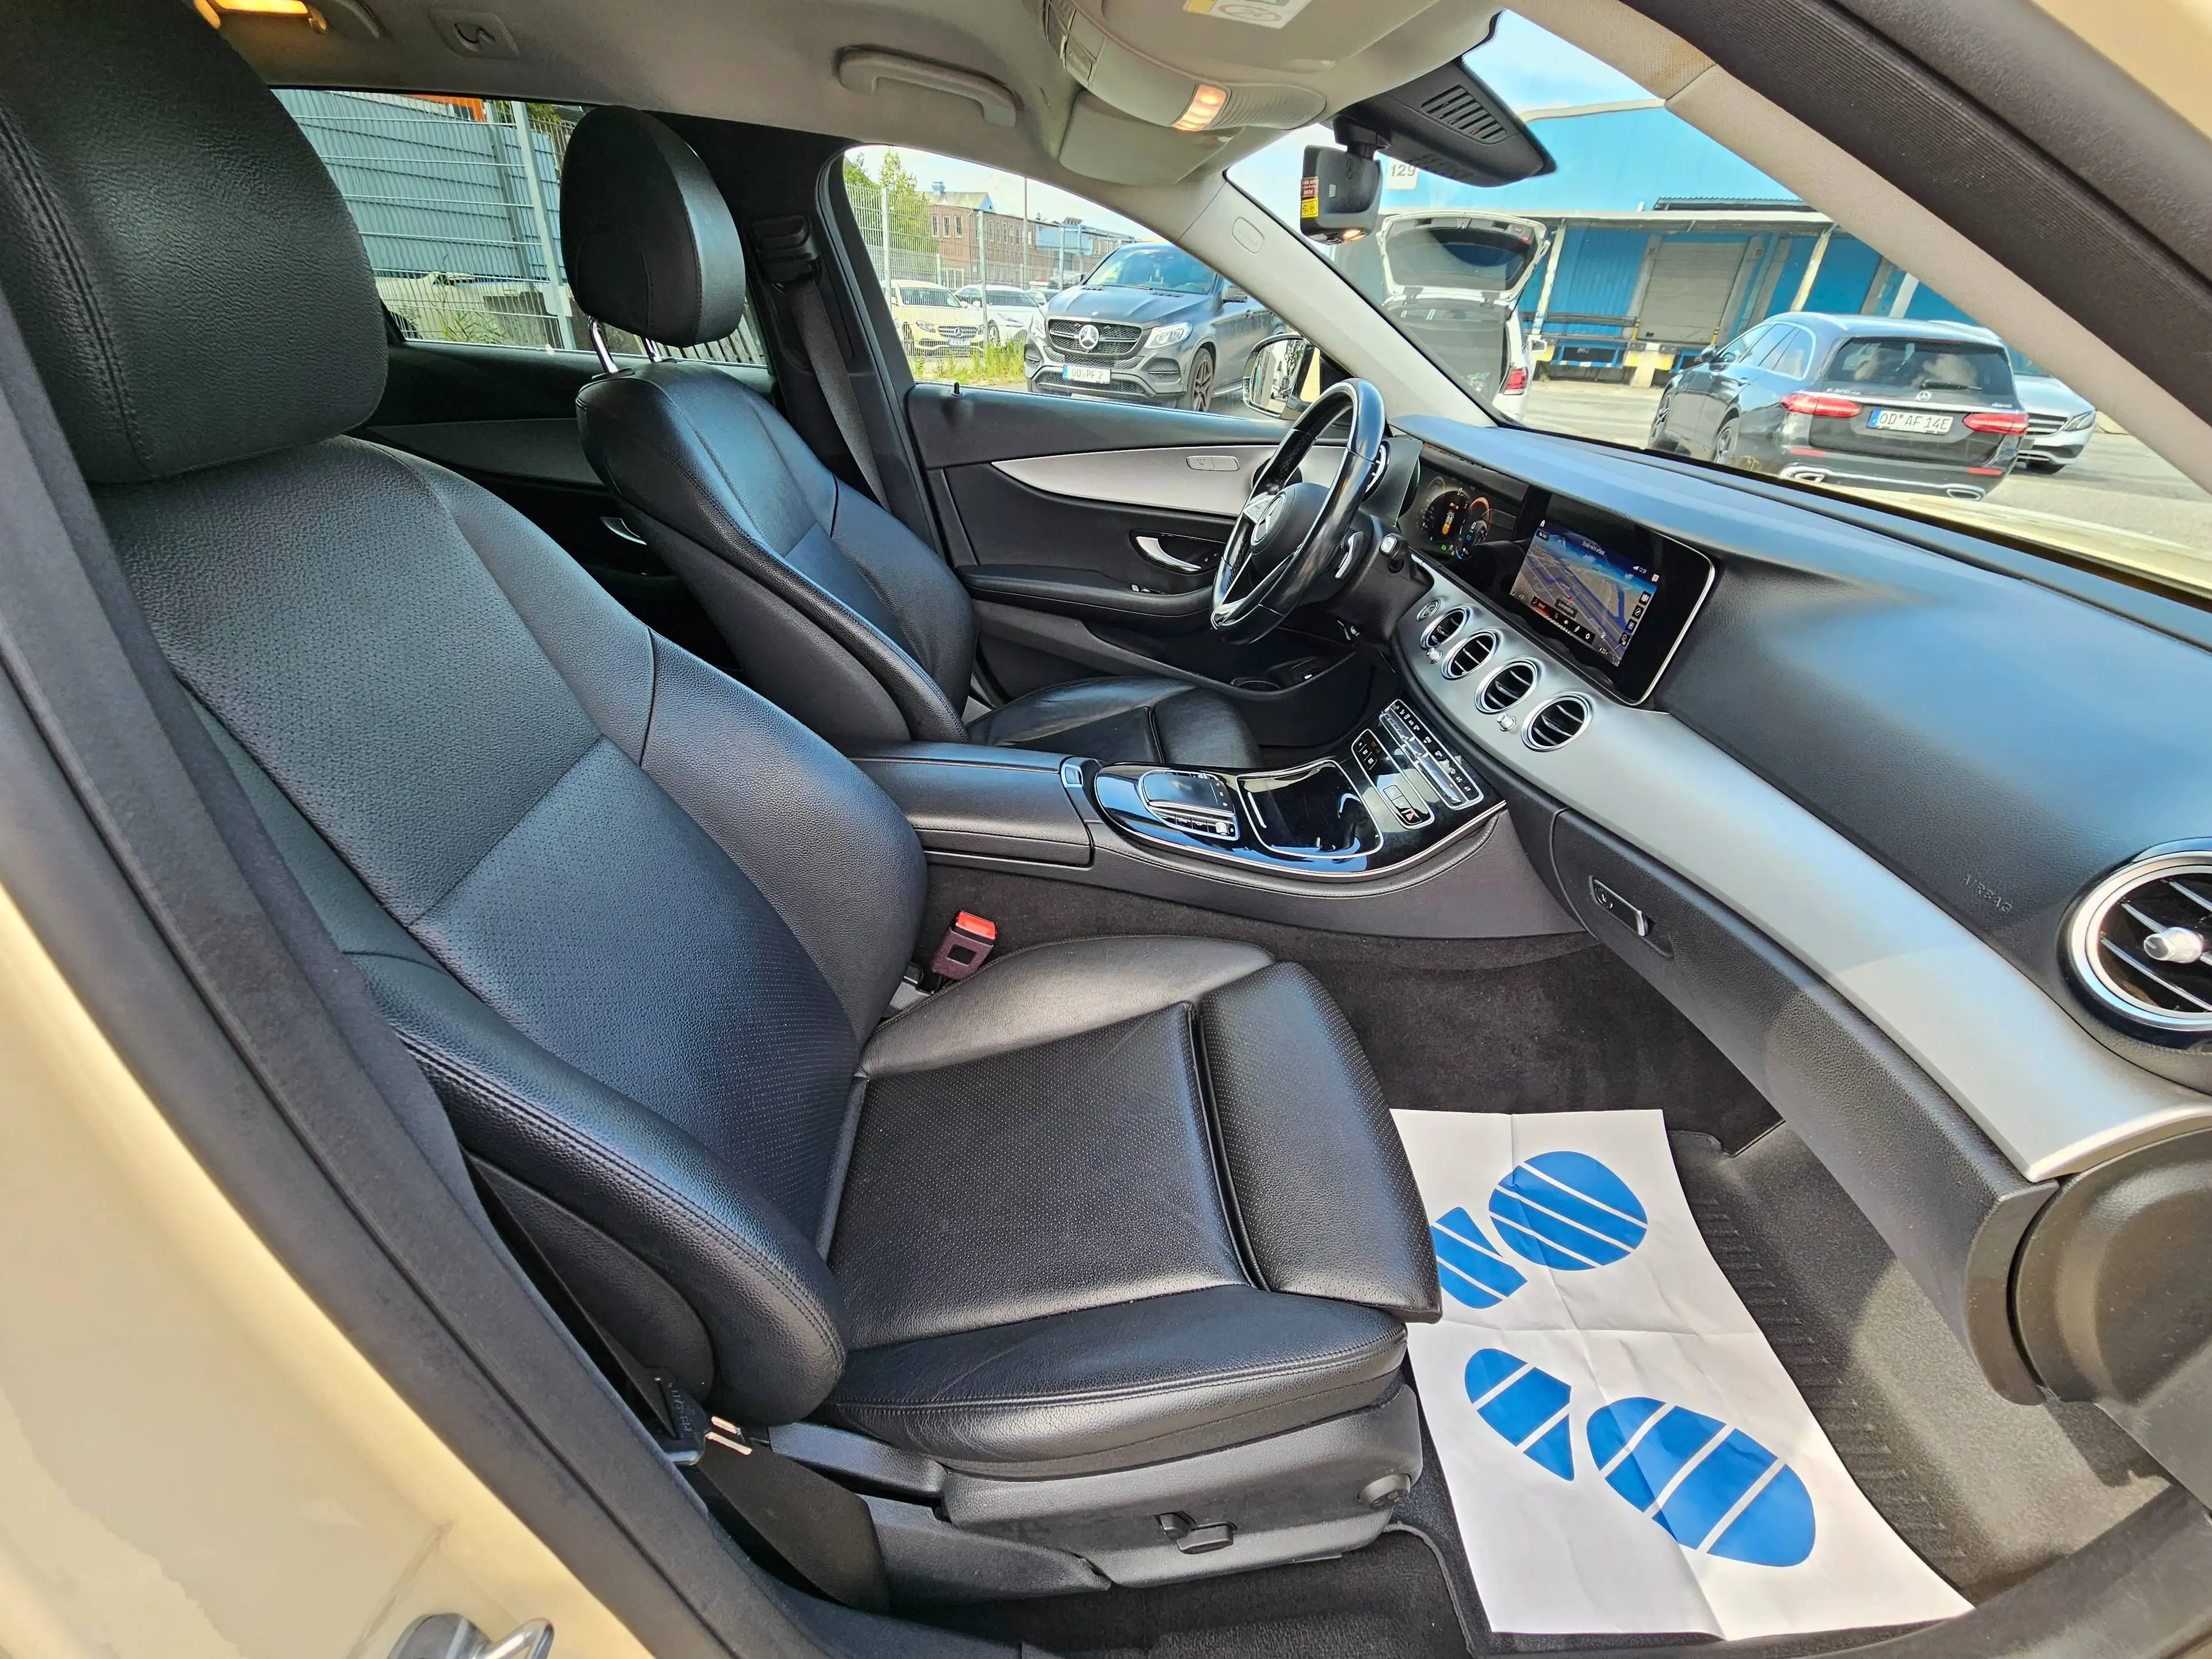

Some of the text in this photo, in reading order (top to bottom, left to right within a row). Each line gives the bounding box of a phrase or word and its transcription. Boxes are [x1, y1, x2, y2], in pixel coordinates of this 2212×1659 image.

[1391, 164, 1416, 177] 129
[1071, 368, 1081, 377] OD
[1098, 371, 1103, 380] 2
[1880, 412, 1950, 430] OD AF 14E
